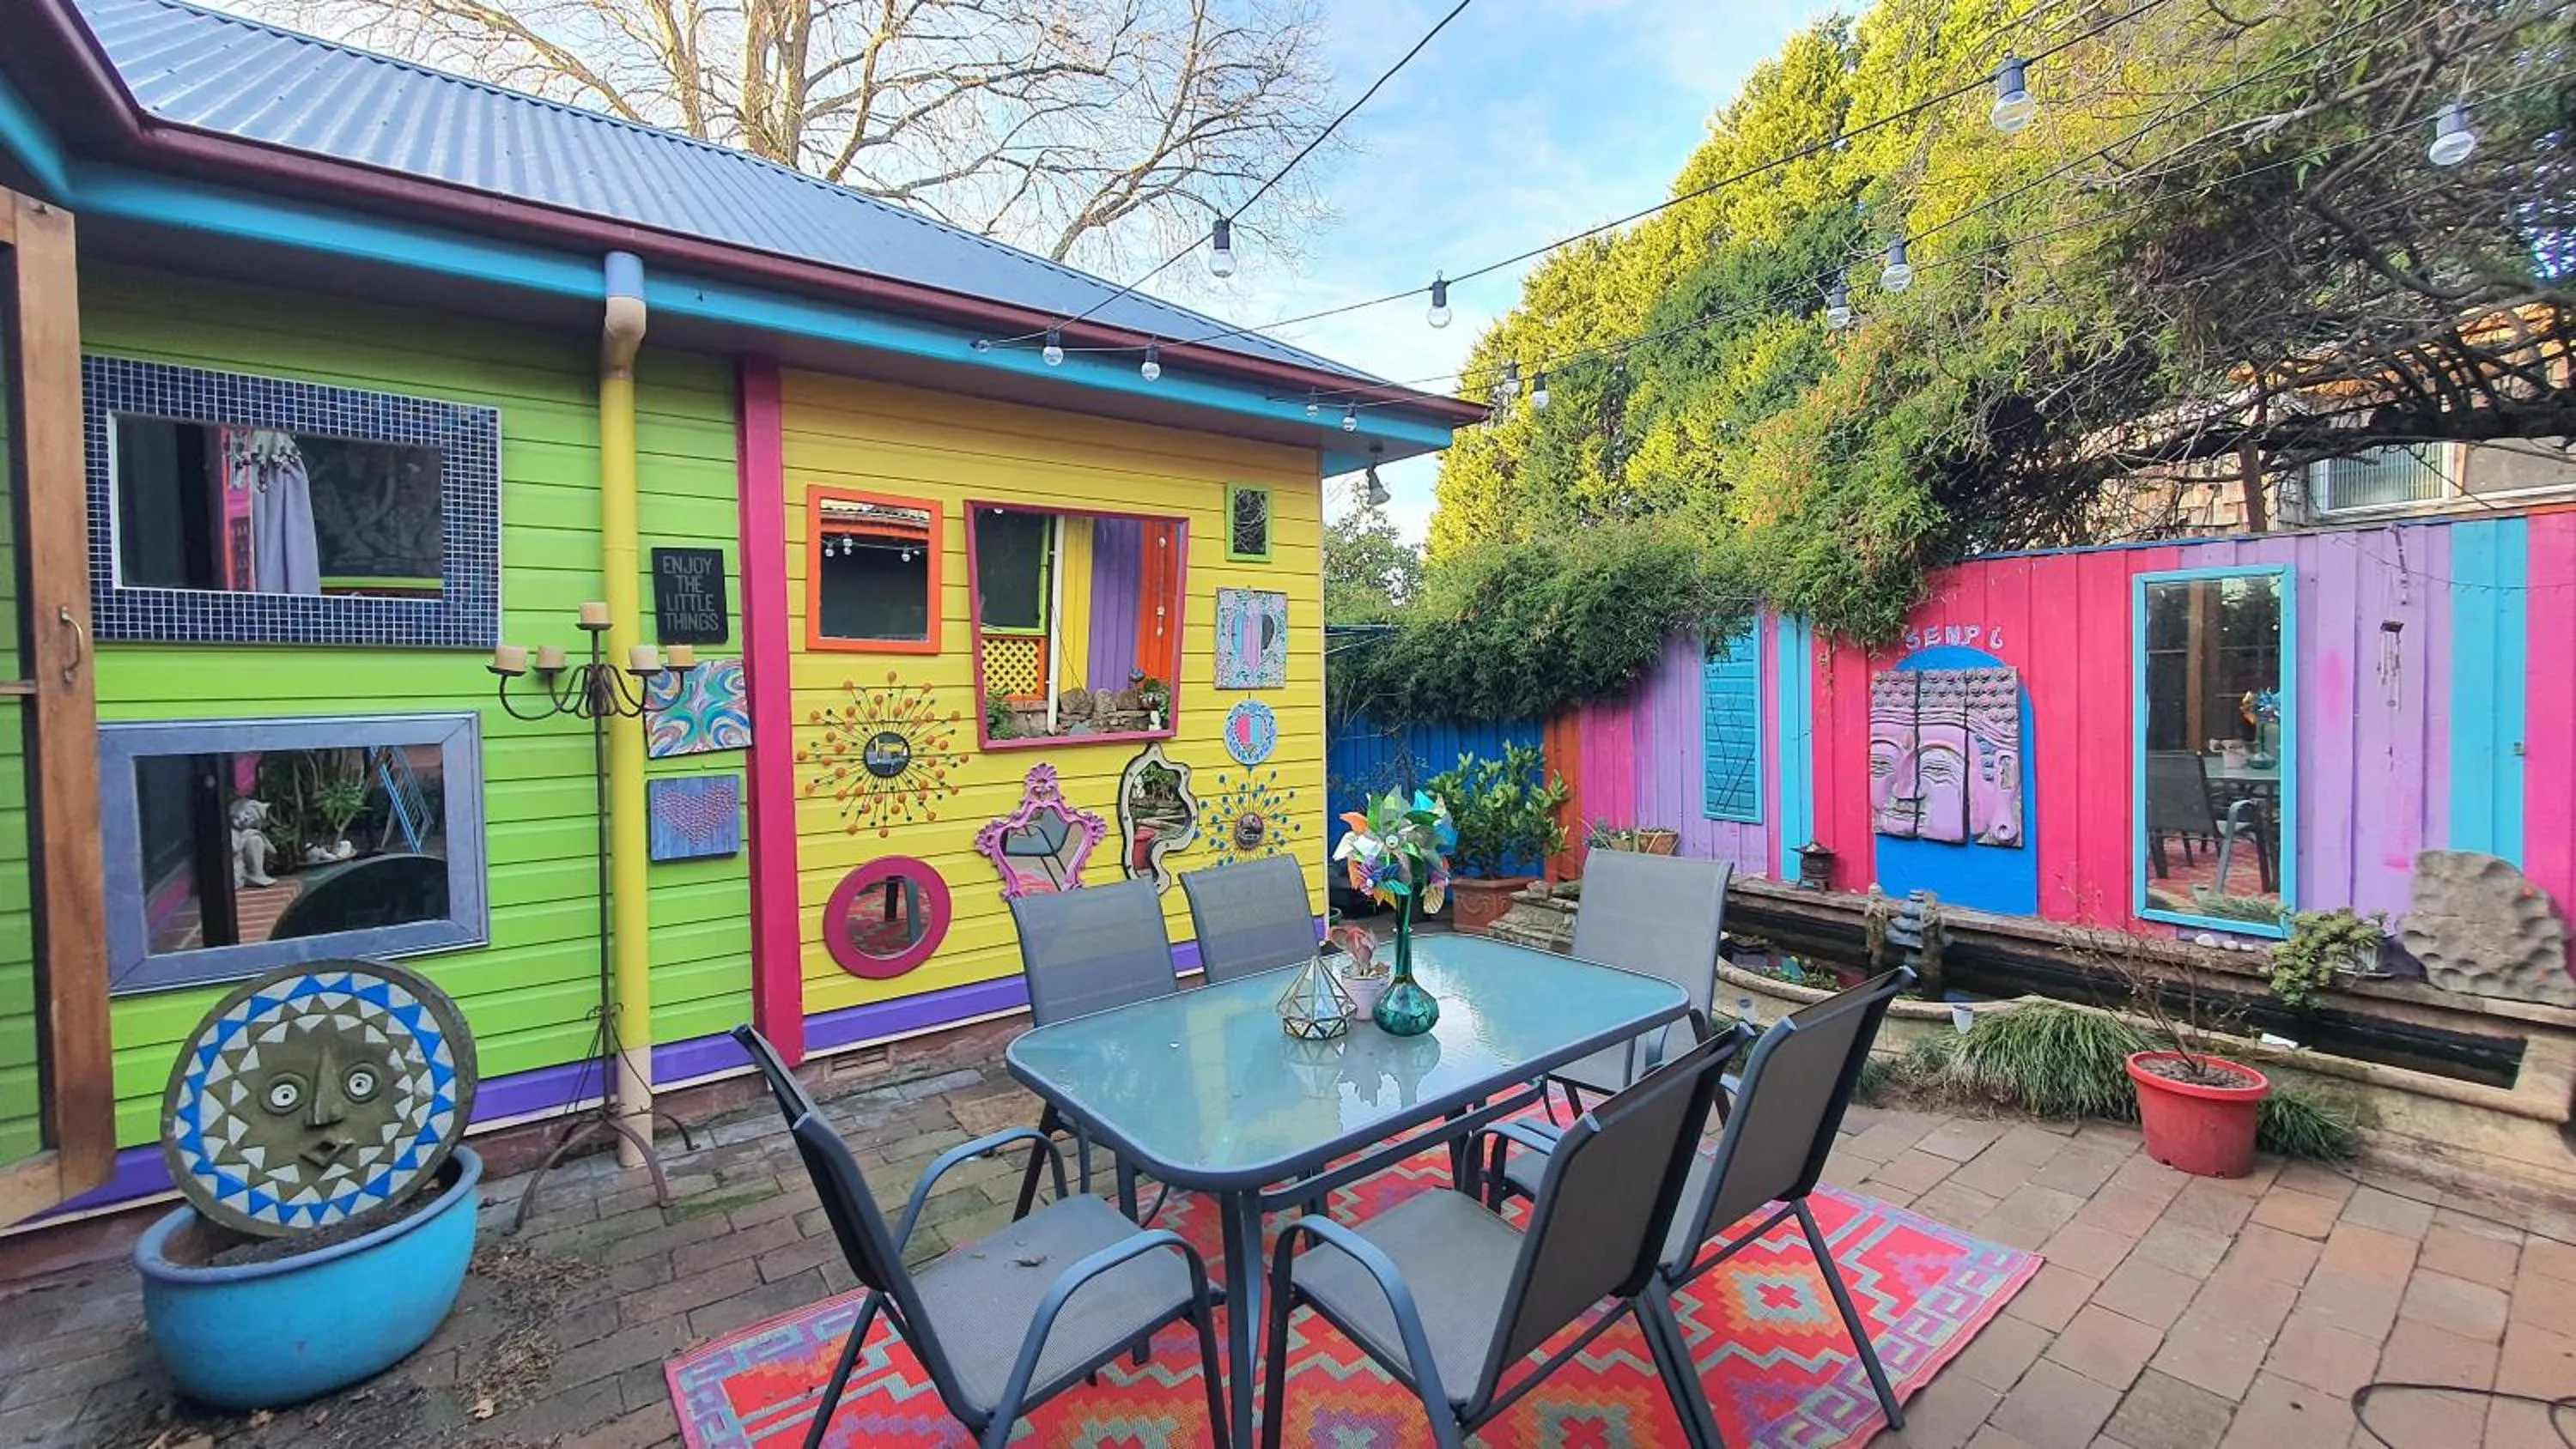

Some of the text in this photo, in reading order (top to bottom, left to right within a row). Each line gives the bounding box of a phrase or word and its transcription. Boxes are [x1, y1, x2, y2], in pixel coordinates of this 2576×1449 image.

[662, 555, 712, 574] ENJOY
[676, 574, 704, 593] THE
[665, 593, 715, 612] LITTLE
[665, 612, 720, 631] THINGS
